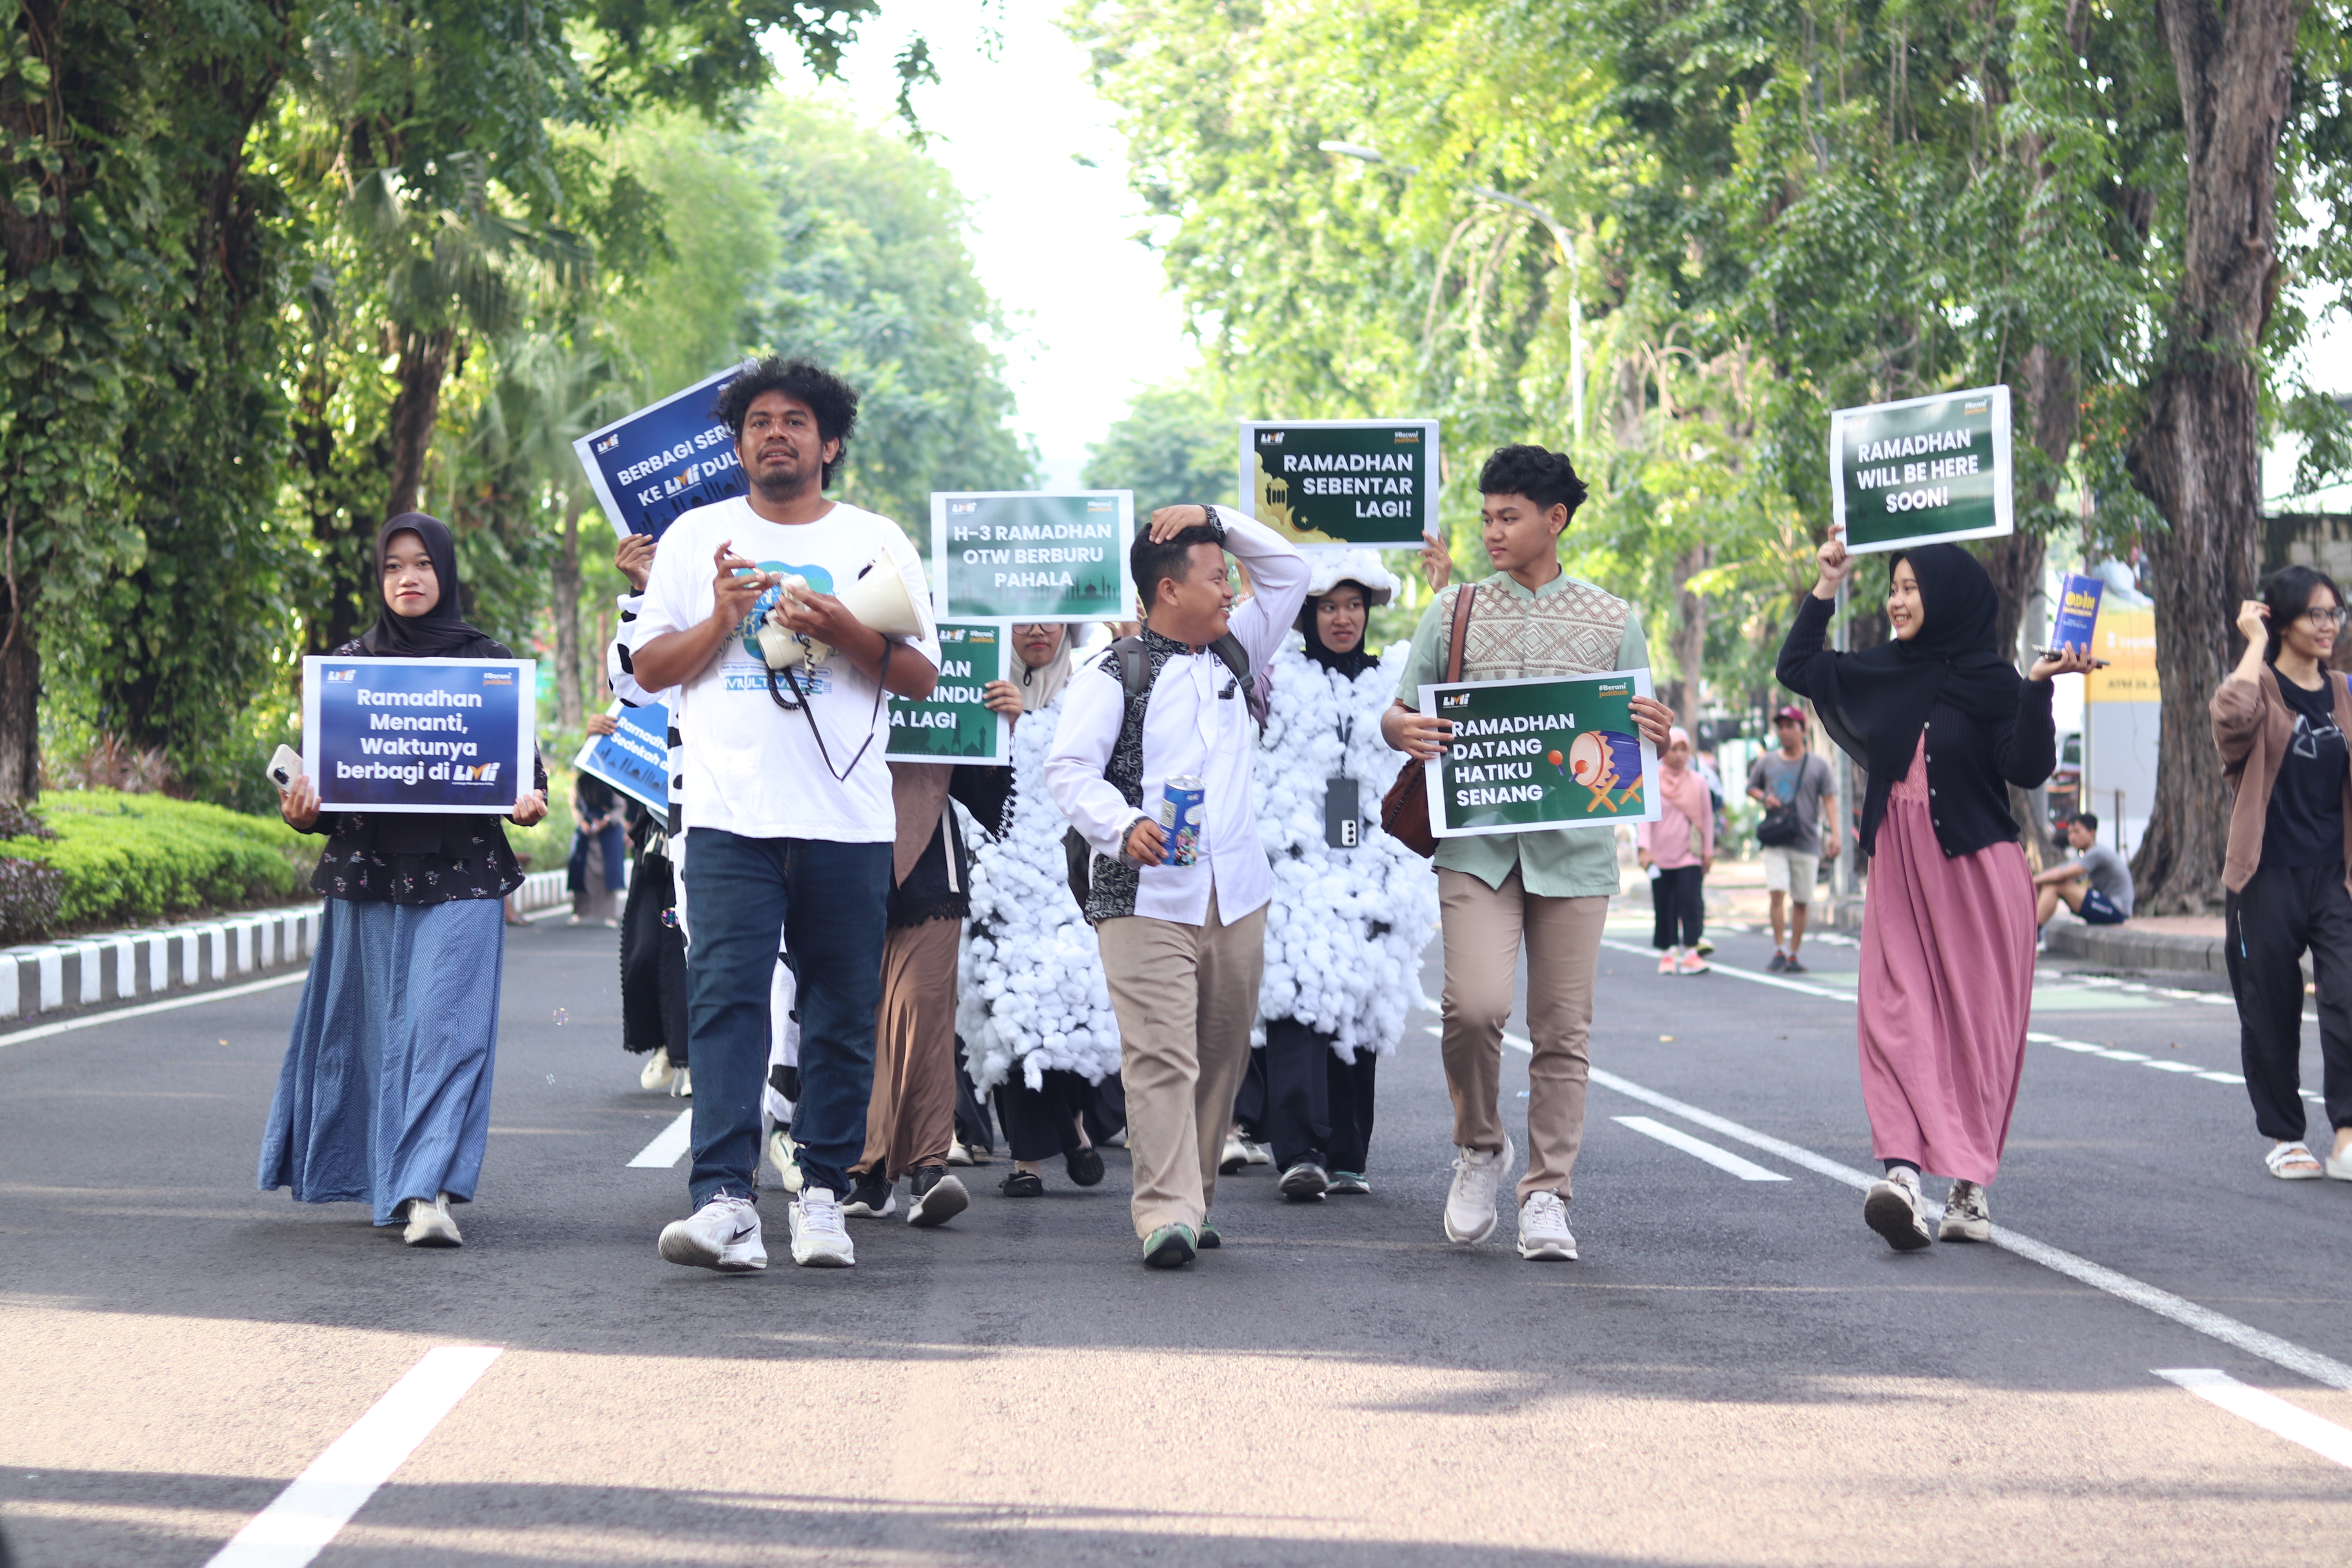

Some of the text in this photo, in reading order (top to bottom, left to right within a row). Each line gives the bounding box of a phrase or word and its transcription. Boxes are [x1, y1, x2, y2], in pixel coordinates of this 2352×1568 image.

[1858, 428, 1971, 463] RAMADHAN
[617, 440, 695, 486] BERBAGI
[1283, 453, 1413, 472] RAMADHAN
[1857, 454, 1978, 490] WILL BE HERE
[637, 485, 664, 507] KE
[701, 448, 740, 477] DUL
[1303, 477, 1413, 495] SEBENTAR
[1356, 500, 1411, 518] LAGI!
[1886, 485, 1949, 514] SOON!
[953, 523, 1112, 541] H-3 RAMADHAN
[962, 547, 1104, 565] OTW BERBURU
[994, 570, 1074, 588] PAHALA
[1599, 682, 1626, 691] #Berani
[358, 689, 482, 708] Ramadhan
[370, 713, 468, 735] Menanti,
[910, 711, 957, 729] LAGI
[1452, 713, 1575, 738] RAMADHAN
[360, 737, 477, 762] Waktunya
[610, 732, 660, 768] Sedekah
[1453, 738, 1543, 760] DATANG
[337, 762, 424, 785] berbagi
[428, 762, 450, 780] di
[1455, 762, 1532, 784] HATIKU
[1456, 784, 1543, 807] SENANG
